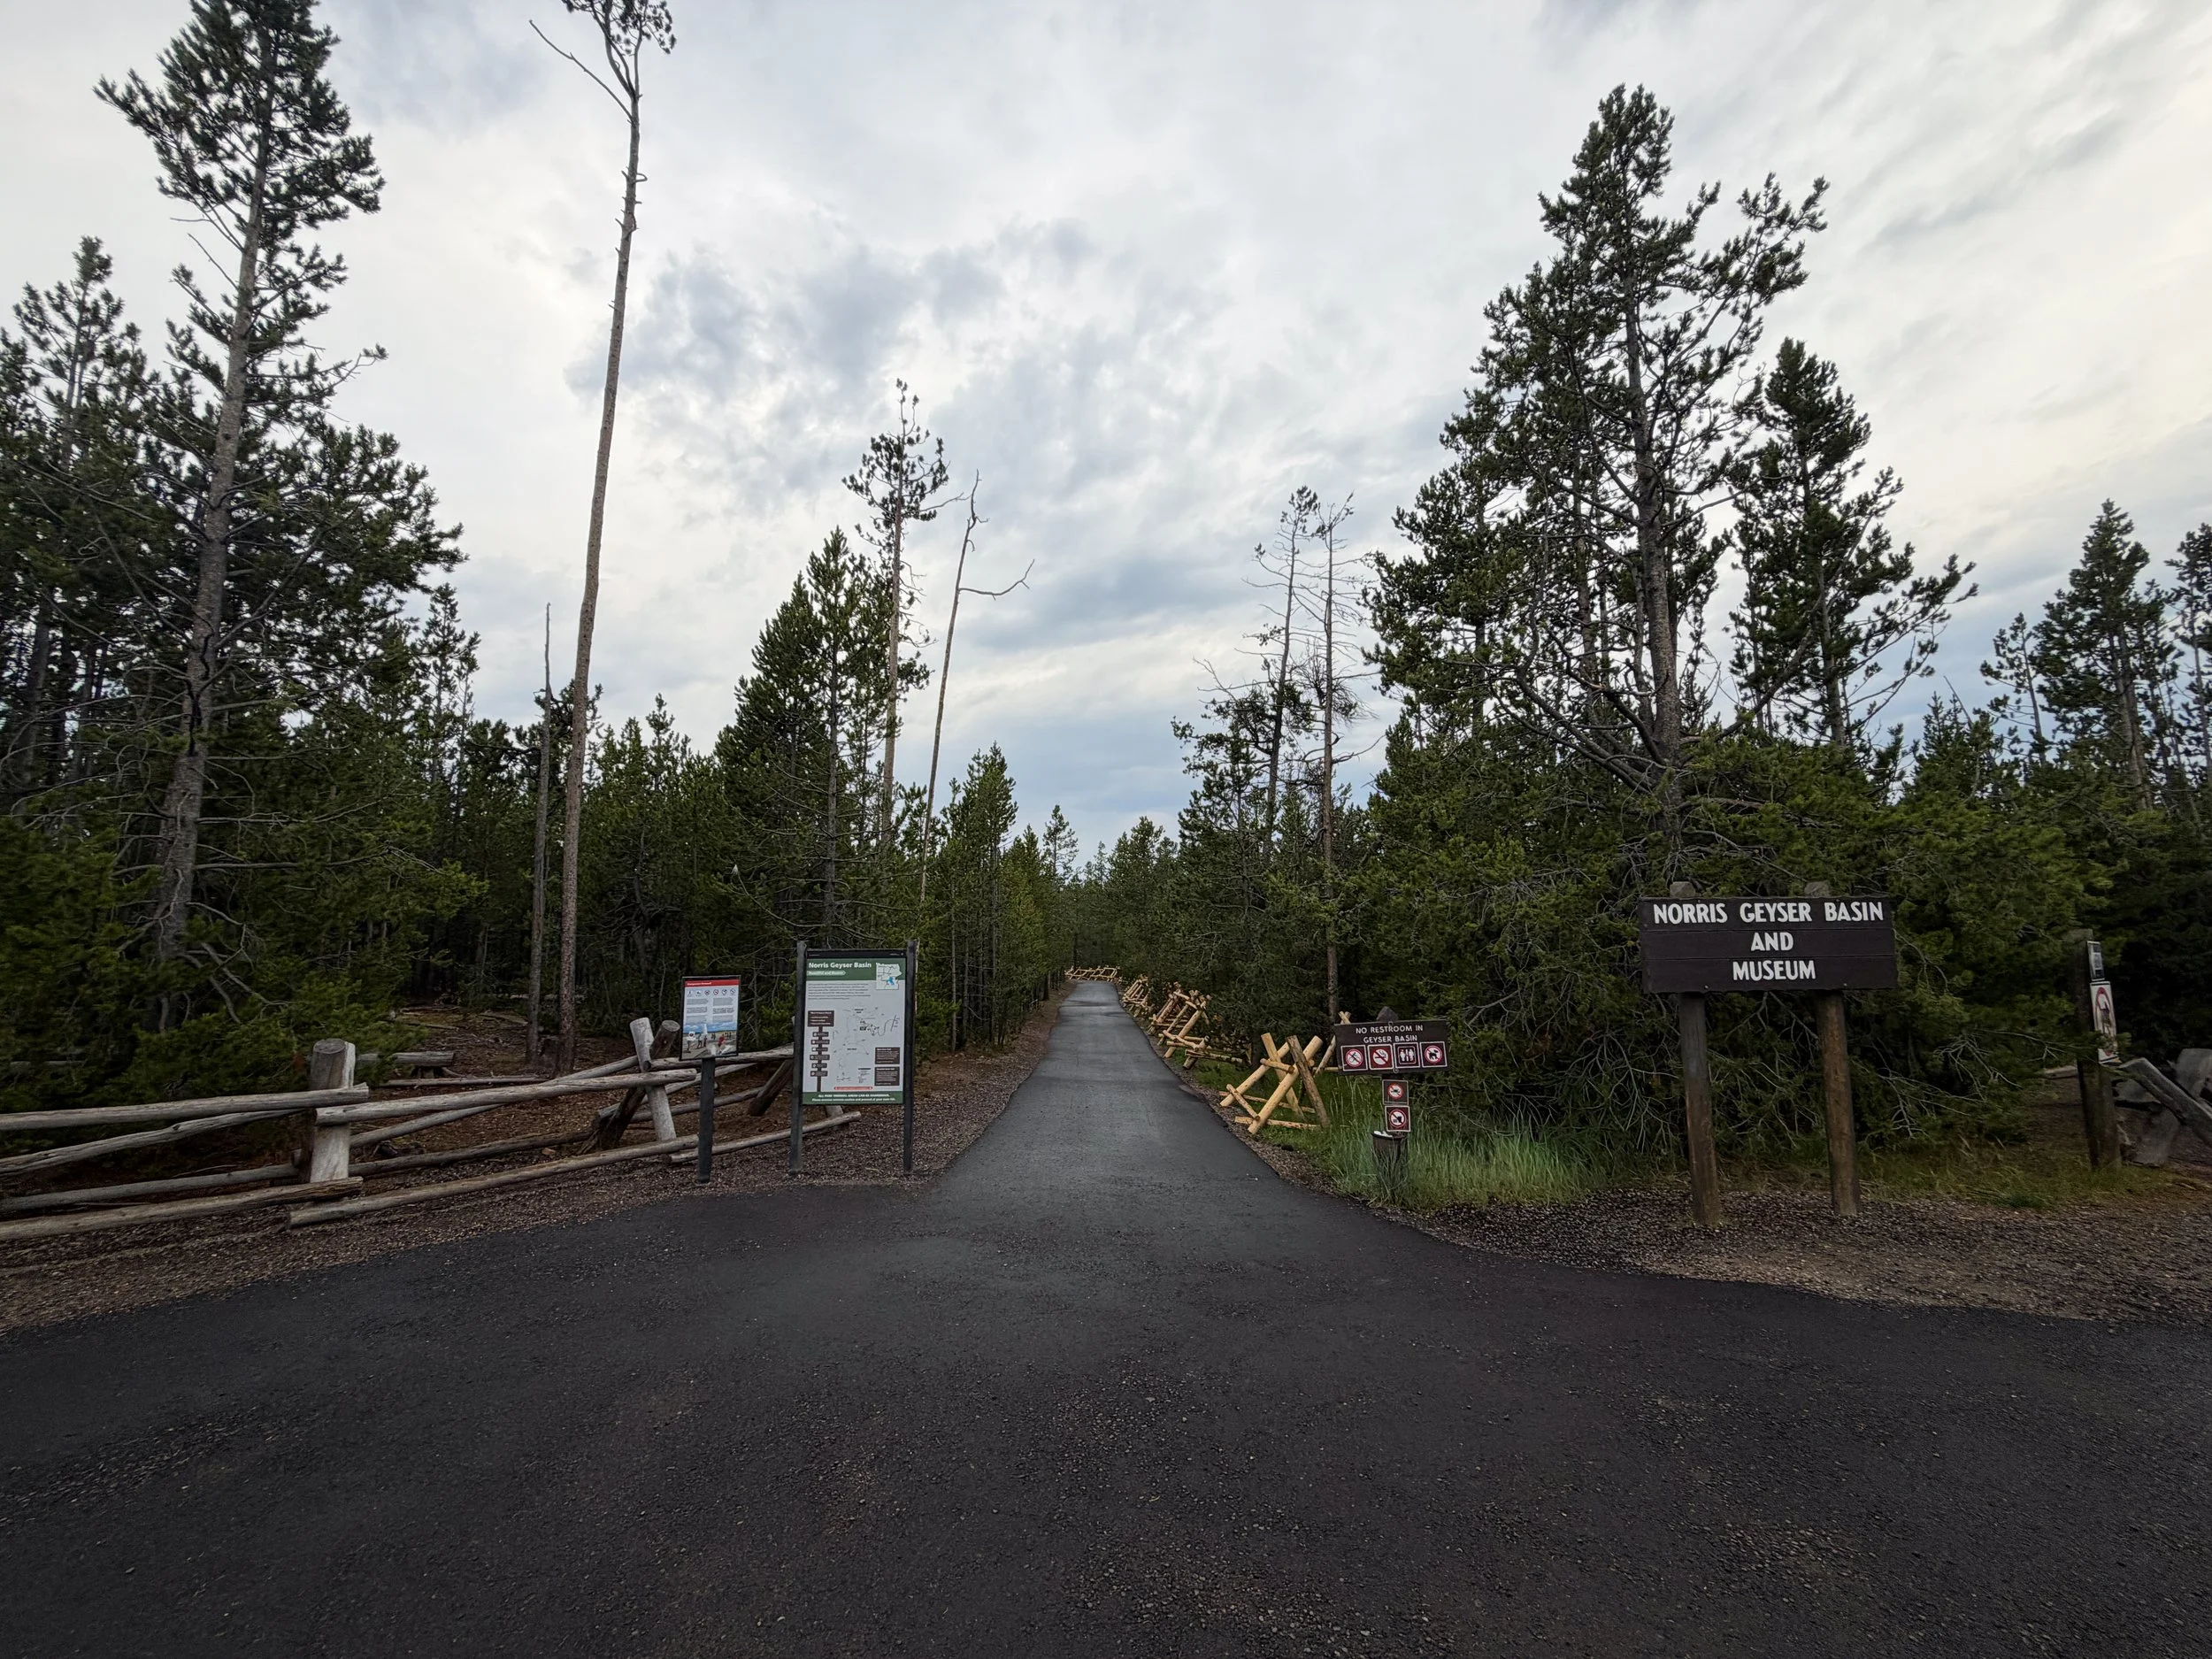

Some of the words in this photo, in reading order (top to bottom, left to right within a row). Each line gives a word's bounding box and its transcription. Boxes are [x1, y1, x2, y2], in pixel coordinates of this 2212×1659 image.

[1654, 902, 1728, 925] NORRIS
[1740, 902, 1812, 923] GEYSER
[1824, 902, 1884, 922] BASIN
[1750, 932, 1794, 951] AND
[1732, 960, 1816, 981] MUSEUM
